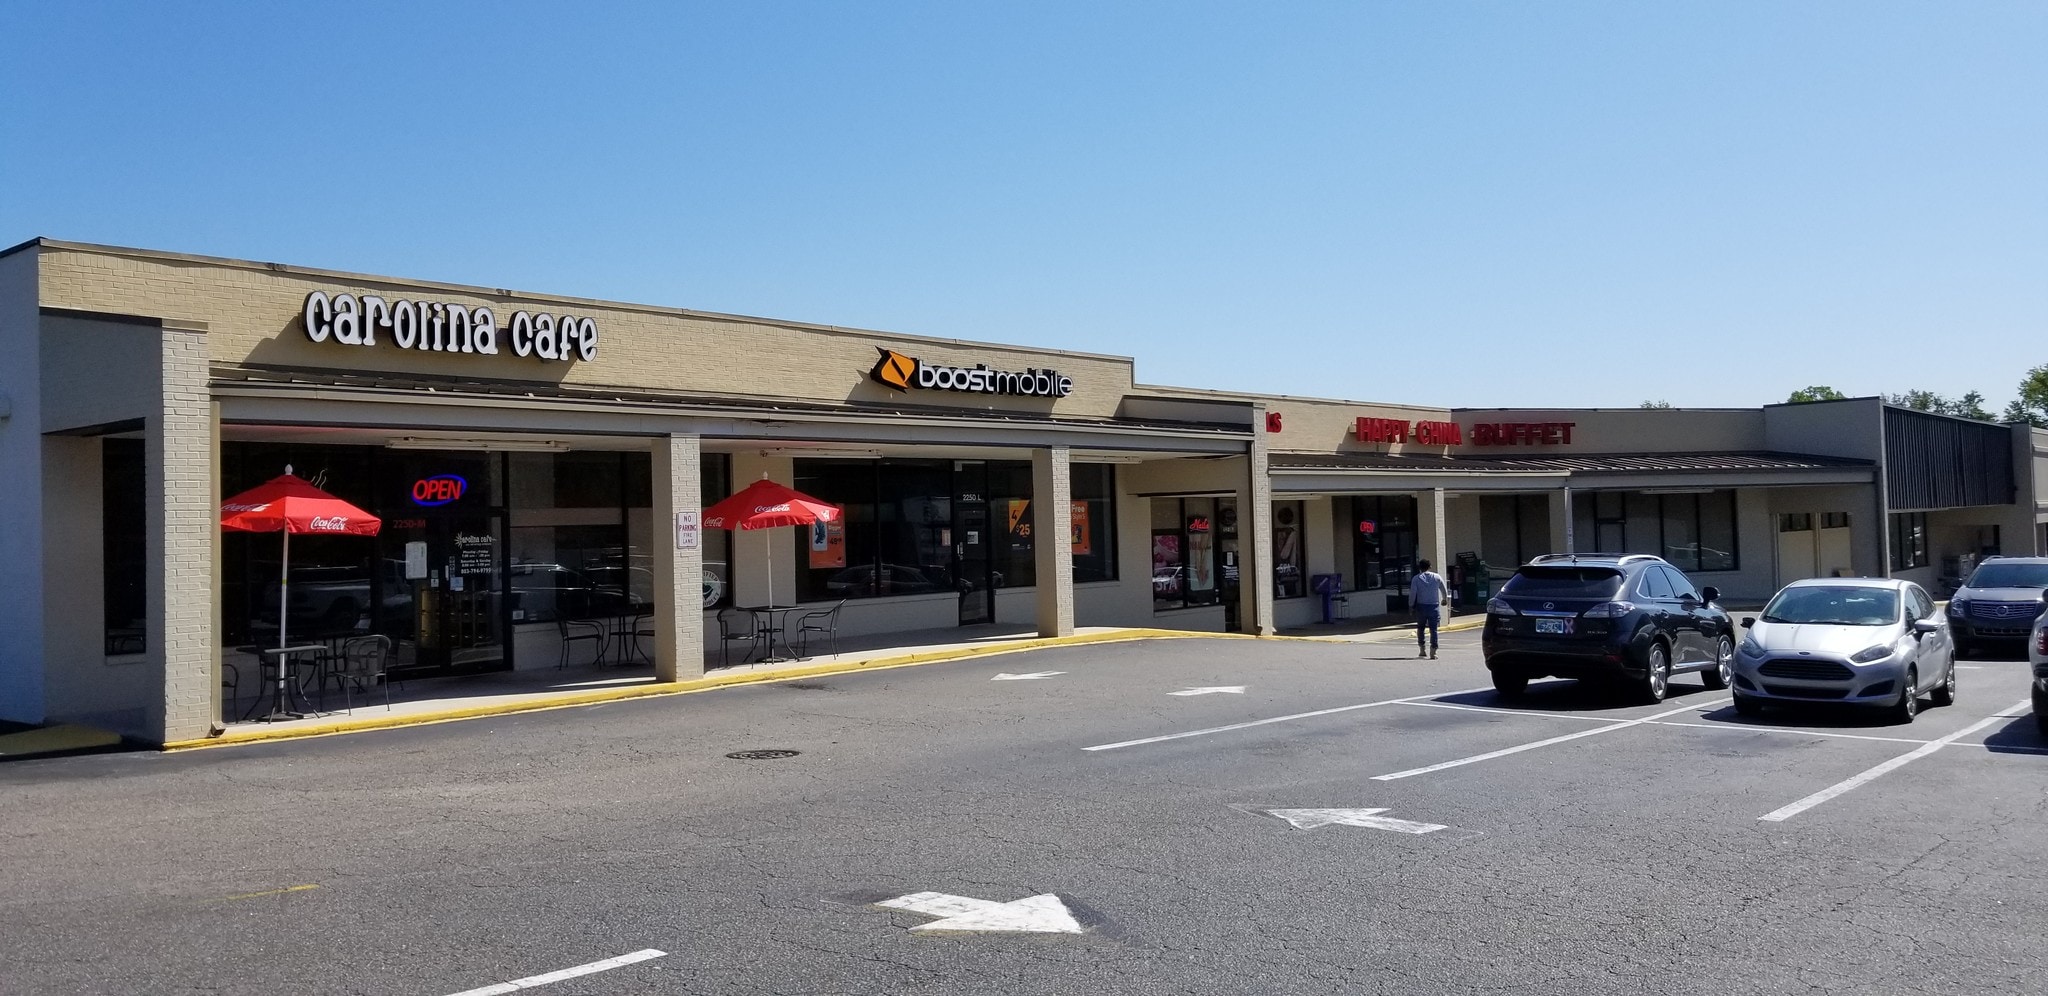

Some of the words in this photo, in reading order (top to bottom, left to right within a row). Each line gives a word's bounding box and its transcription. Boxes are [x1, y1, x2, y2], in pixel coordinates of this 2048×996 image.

[511, 310, 598, 362] cafe
[1356, 416, 1410, 444] HAPPY
[1415, 419, 1462, 446] CHINA
[1473, 422, 1576, 446] BUFFET
[412, 479, 462, 500] OPEN
[679, 524, 697, 532] PARKING
[683, 515, 692, 523] NO
